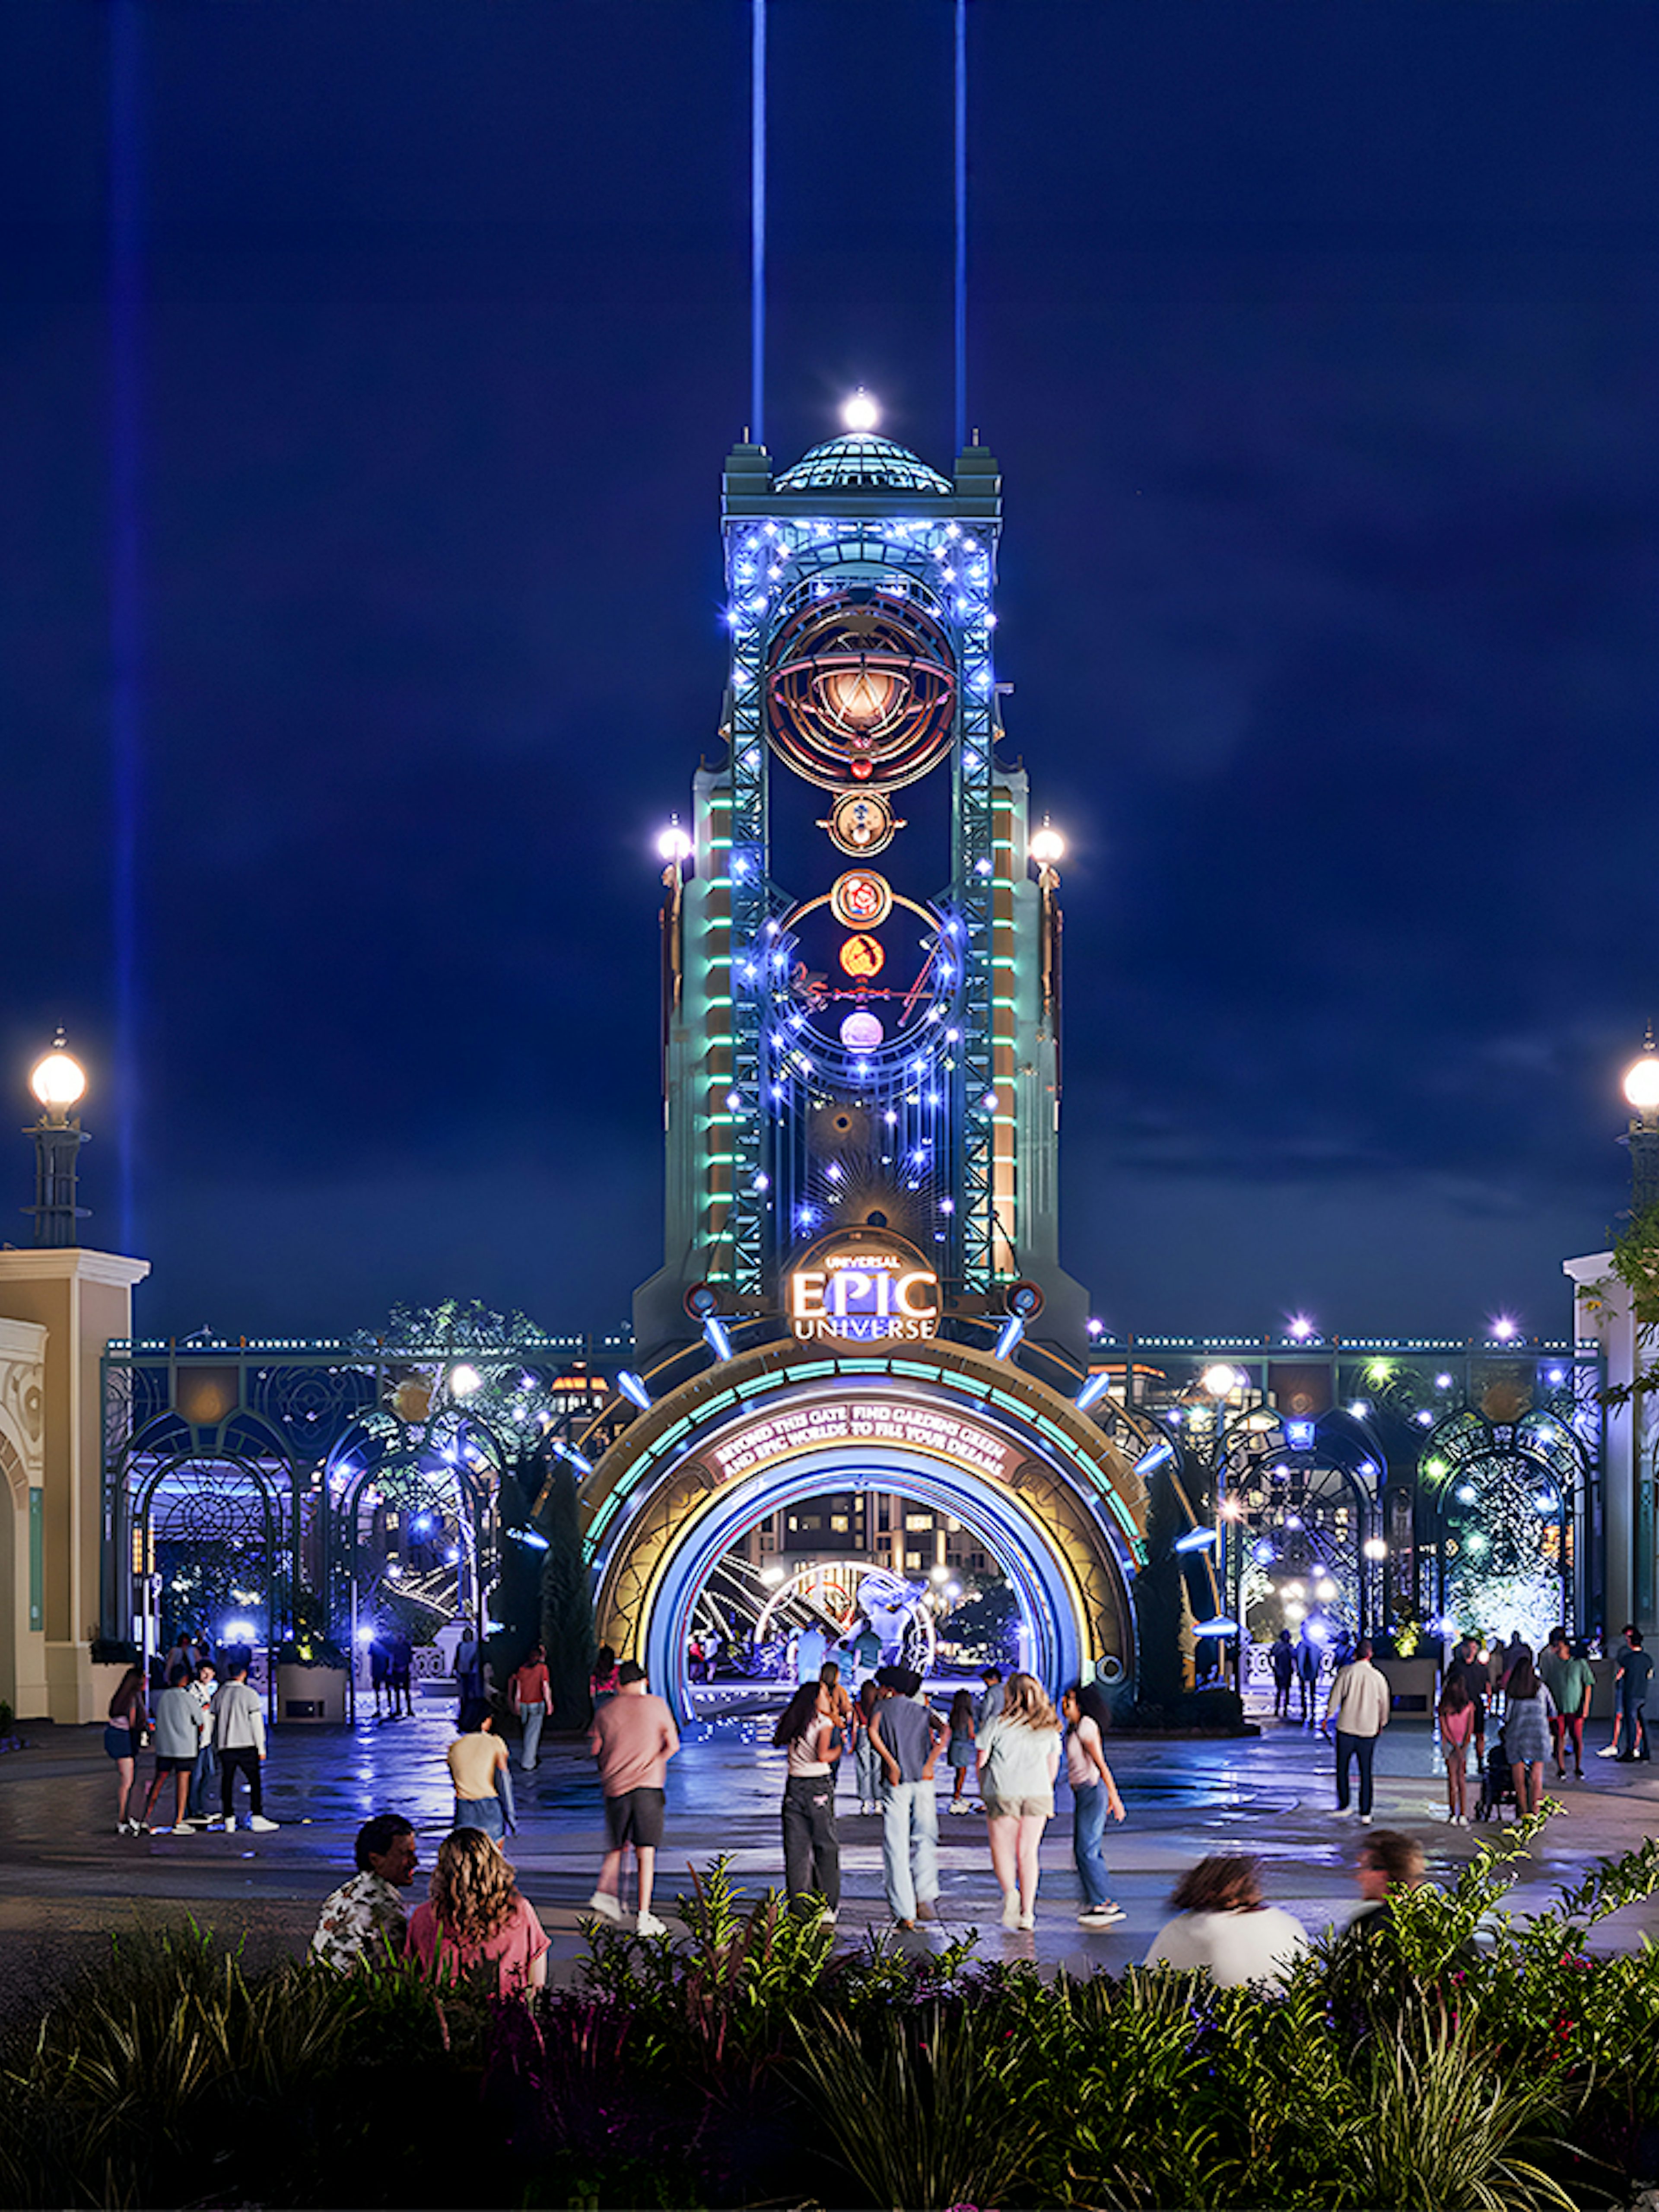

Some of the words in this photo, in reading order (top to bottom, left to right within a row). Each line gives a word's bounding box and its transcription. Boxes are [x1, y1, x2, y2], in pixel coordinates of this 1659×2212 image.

[825, 1255, 901, 1268] UNIVERSAL
[793, 1271, 938, 1317] EPIC
[795, 1319, 935, 1339] UNIVERSE
[713, 1425, 774, 1464] BEYOND
[772, 1412, 808, 1432] THIS
[808, 1406, 847, 1424] GATE
[852, 1406, 891, 1421] FIND
[893, 1407, 961, 1437] GARDENS
[960, 1427, 1007, 1461] GREEN
[724, 1451, 755, 1479] AND
[755, 1436, 788, 1461] EPIC
[788, 1423, 849, 1446] WORLDS
[851, 1421, 874, 1436] TO
[875, 1422, 905, 1438] FILL
[906, 1426, 947, 1450] YOUR
[947, 1437, 1005, 1477] DREAMS
